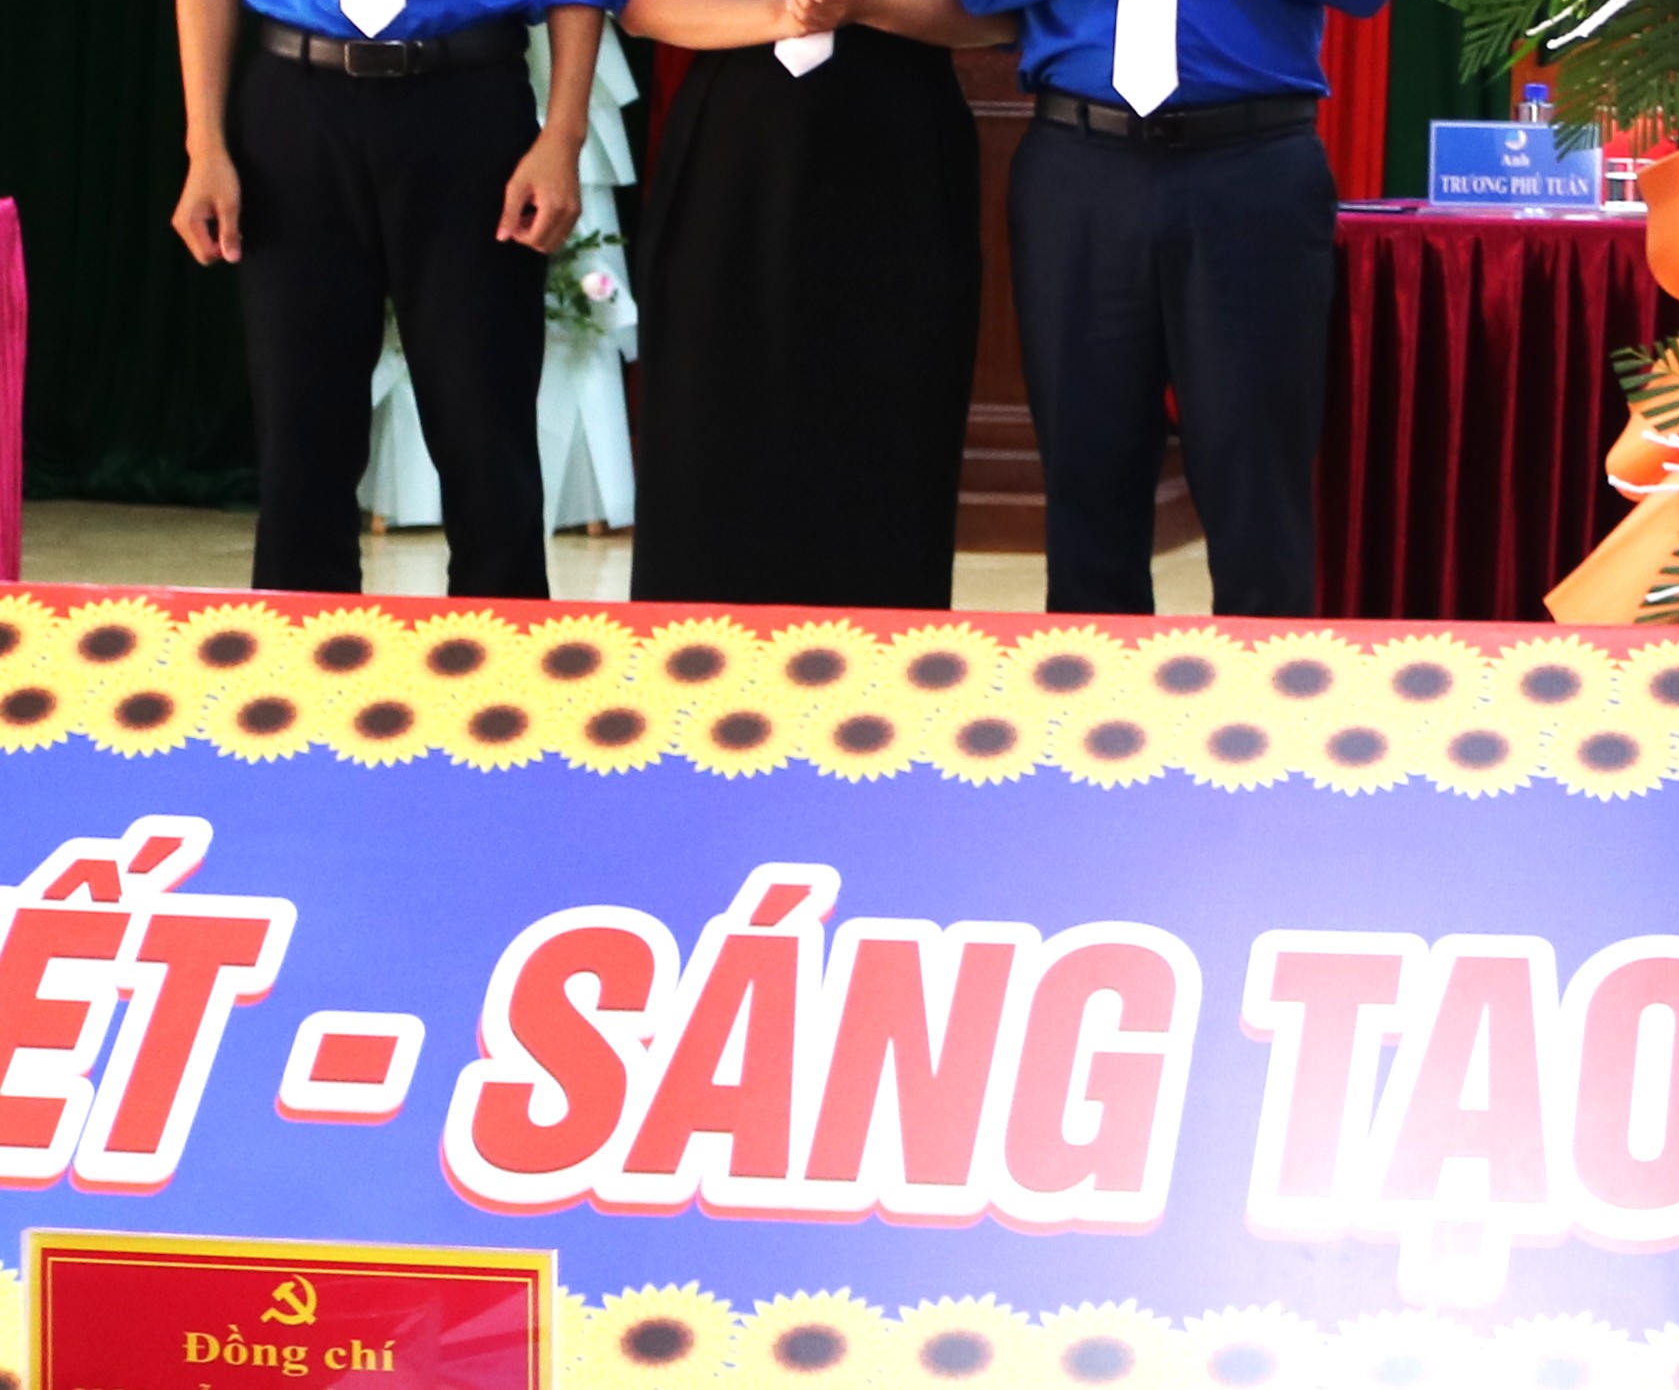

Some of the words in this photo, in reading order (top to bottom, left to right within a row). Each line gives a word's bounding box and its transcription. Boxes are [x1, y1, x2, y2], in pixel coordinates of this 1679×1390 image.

[443, 863, 1201, 1220] SÁNG
[182, 1324, 309, 1377] Đồng
[324, 1339, 395, 1372] chí
